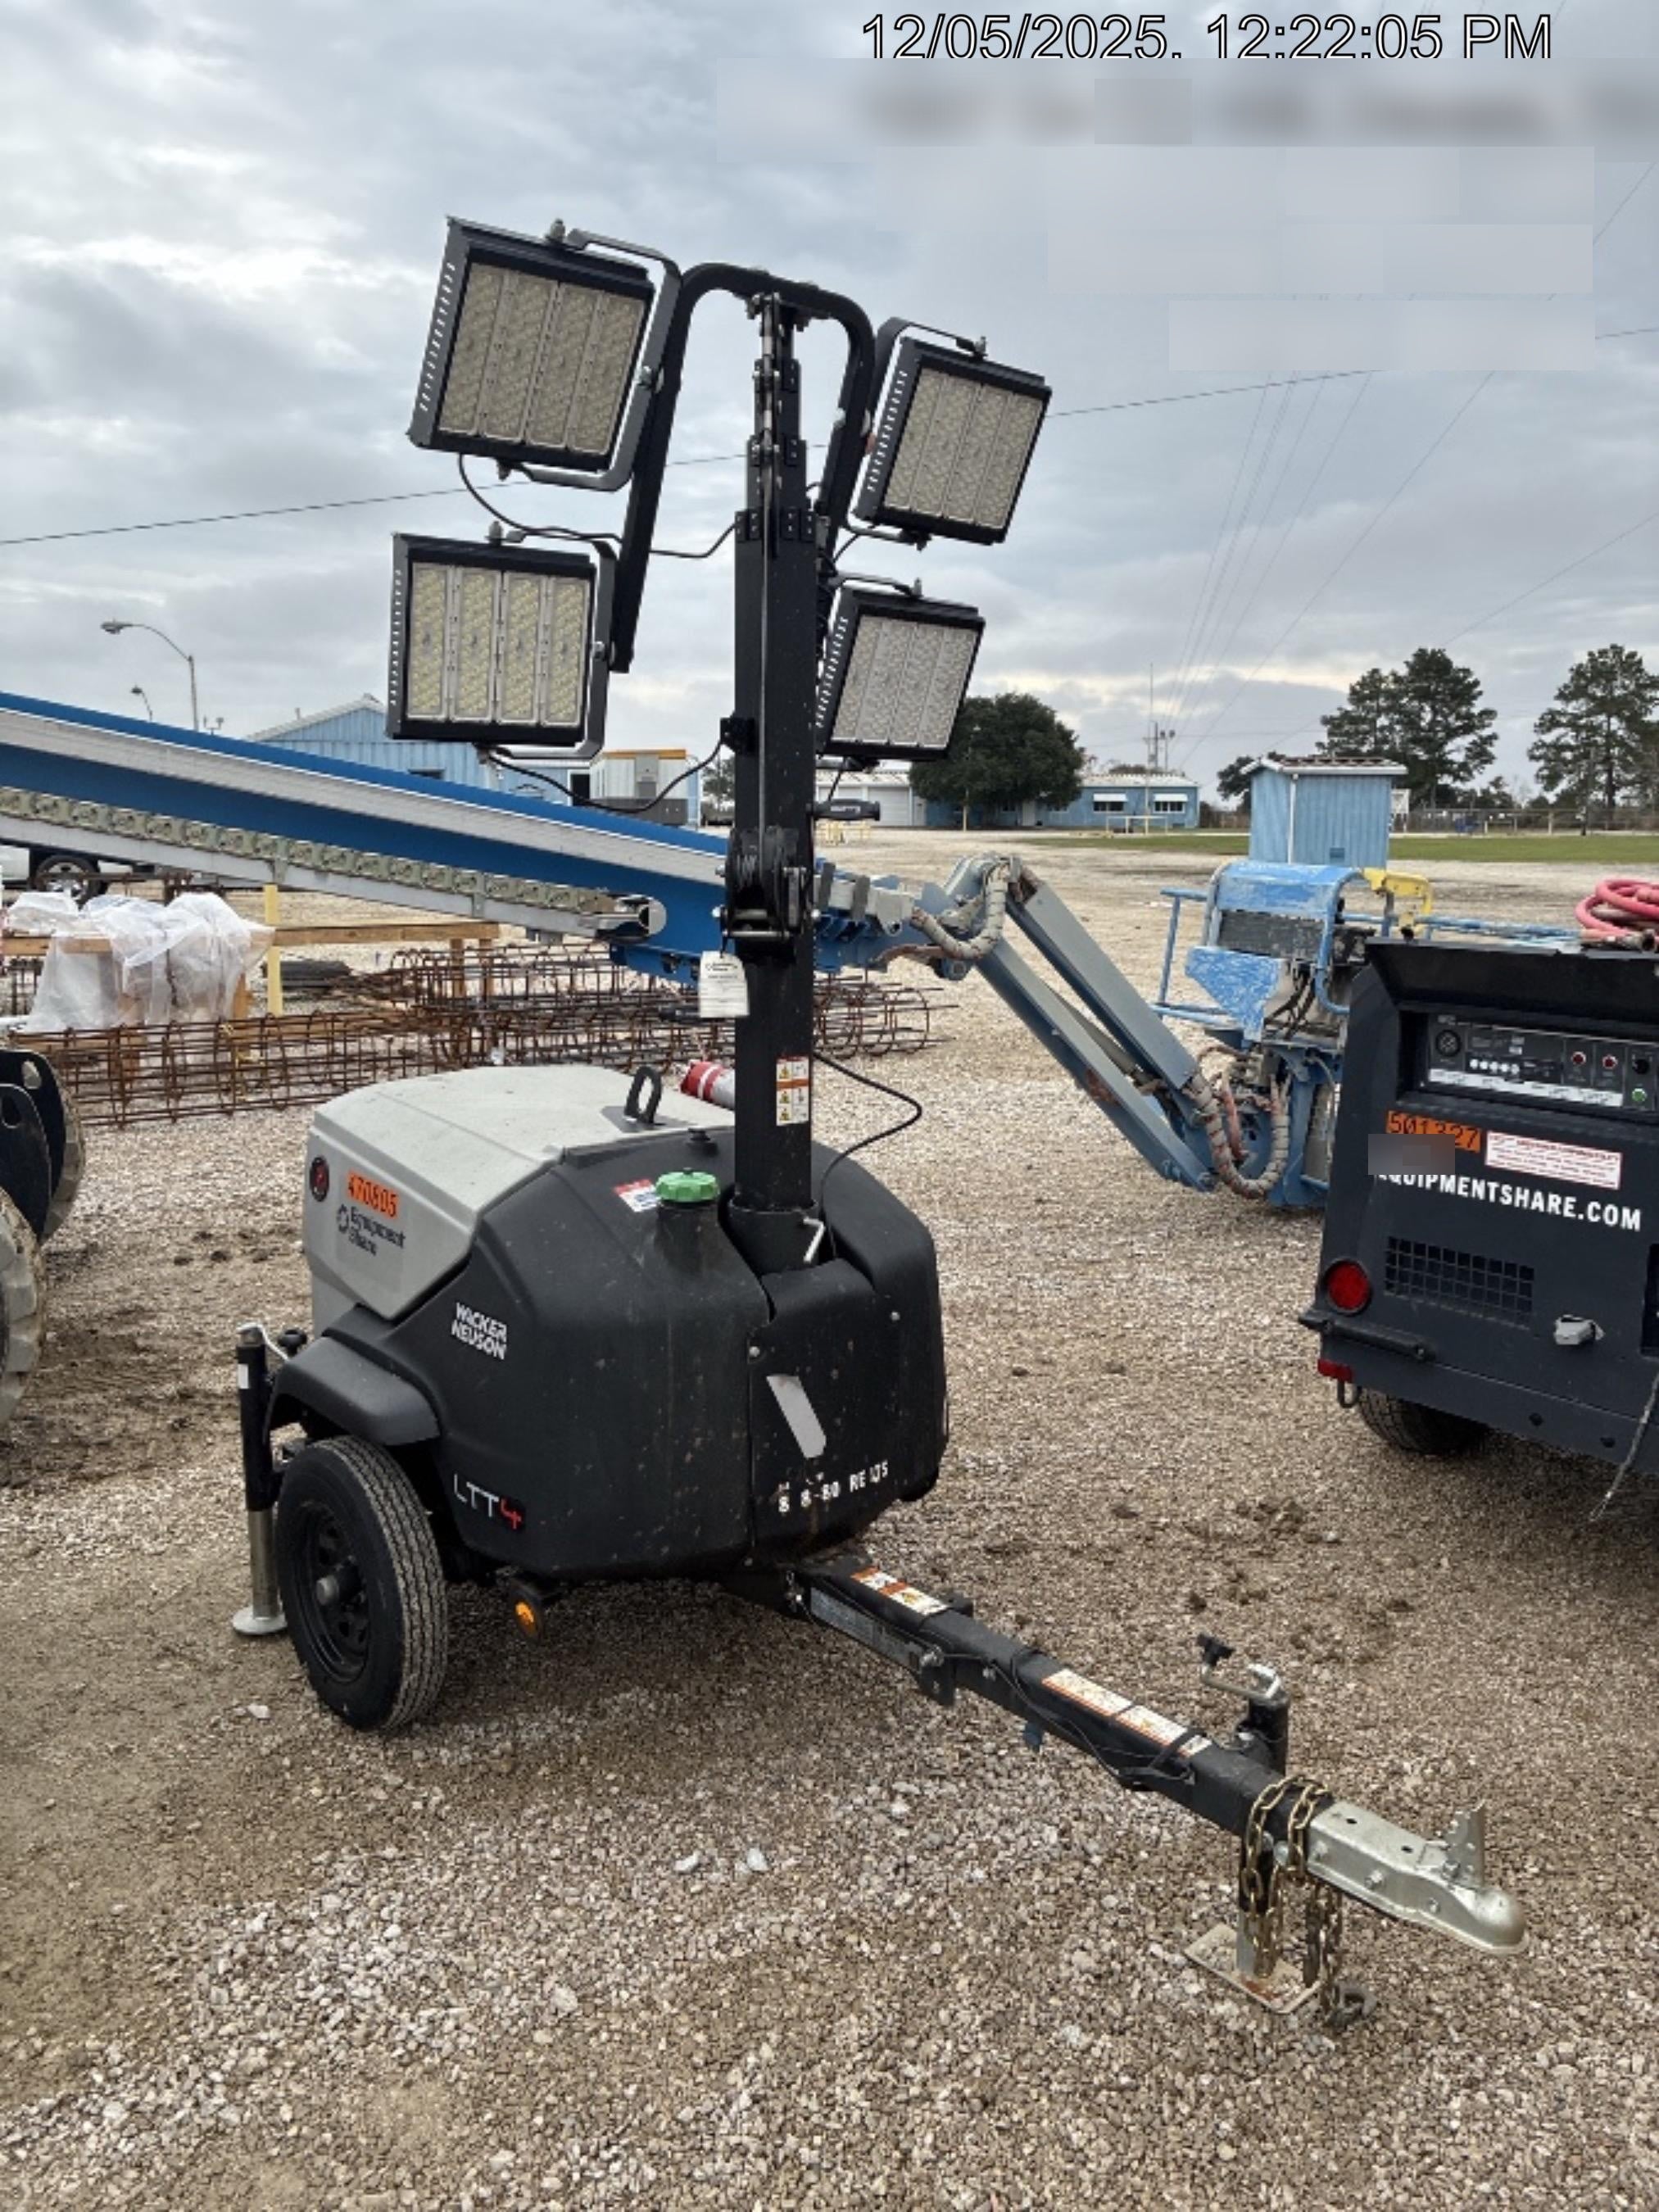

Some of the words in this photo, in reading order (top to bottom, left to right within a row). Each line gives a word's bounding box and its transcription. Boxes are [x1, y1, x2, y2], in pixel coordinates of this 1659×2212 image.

[1378, 1174, 1642, 1231] QUIPMENTSHARE.COM
[451, 1318, 507, 1360] NEUSON
[456, 1301, 507, 1344] WACKER
[453, 1473, 522, 1530] LTT4
